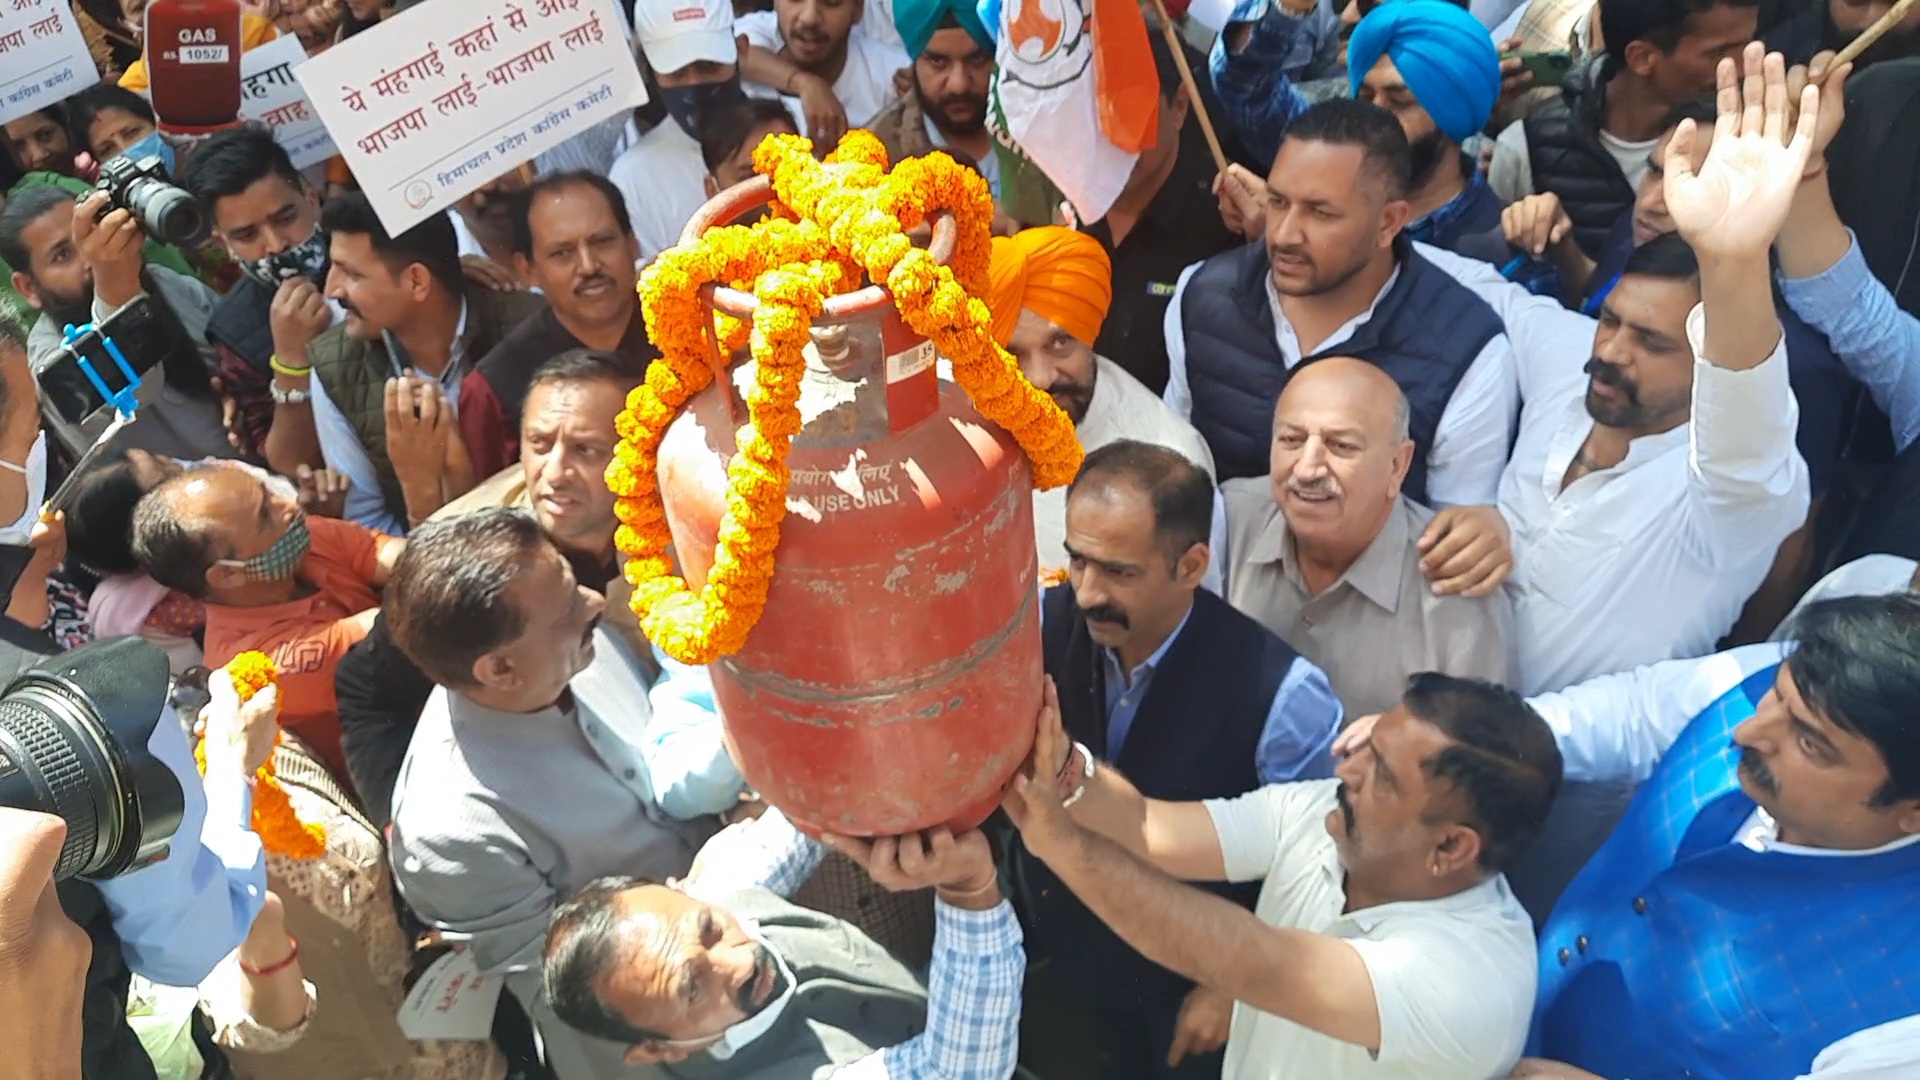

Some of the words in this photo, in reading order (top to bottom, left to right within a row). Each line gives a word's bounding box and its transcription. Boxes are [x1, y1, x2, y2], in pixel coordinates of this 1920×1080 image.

[28, 7, 63, 40] लाई
[178, 28, 216, 43] GAS
[186, 49, 223, 60] 1052/
[342, 85, 368, 114] ये
[370, 42, 446, 99] मंहगाई
[448, 16, 499, 58] कहां
[503, 3, 528, 33] से
[357, 107, 429, 156] भाजपा
[559, 10, 604, 51] लाई
[437, 150, 492, 188] हिमाचल
[813, 493, 851, 513] USE
[852, 484, 900, 510] ONLY
